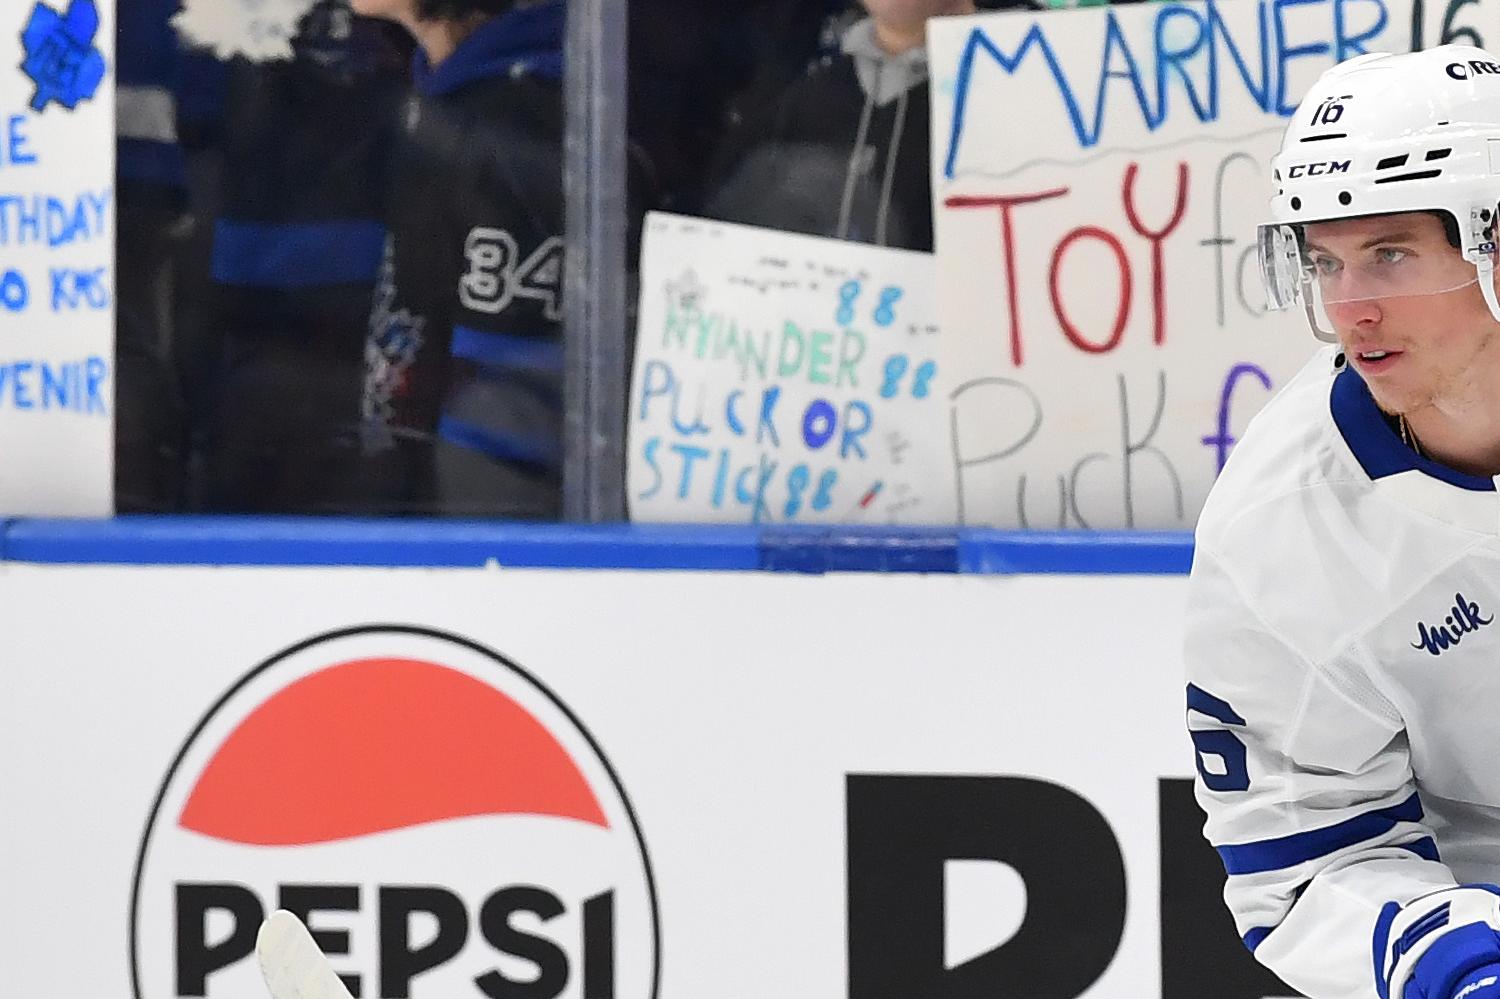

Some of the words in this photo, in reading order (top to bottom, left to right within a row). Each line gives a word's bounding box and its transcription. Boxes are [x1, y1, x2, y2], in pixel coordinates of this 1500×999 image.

[944, 0, 1389, 179] MARNER
[1288, 159, 1352, 179] CCM
[944, 161, 1190, 366] TOY
[836, 279, 903, 327] 88
[802, 399, 874, 459] OR
[1410, 592, 1495, 656] milk
